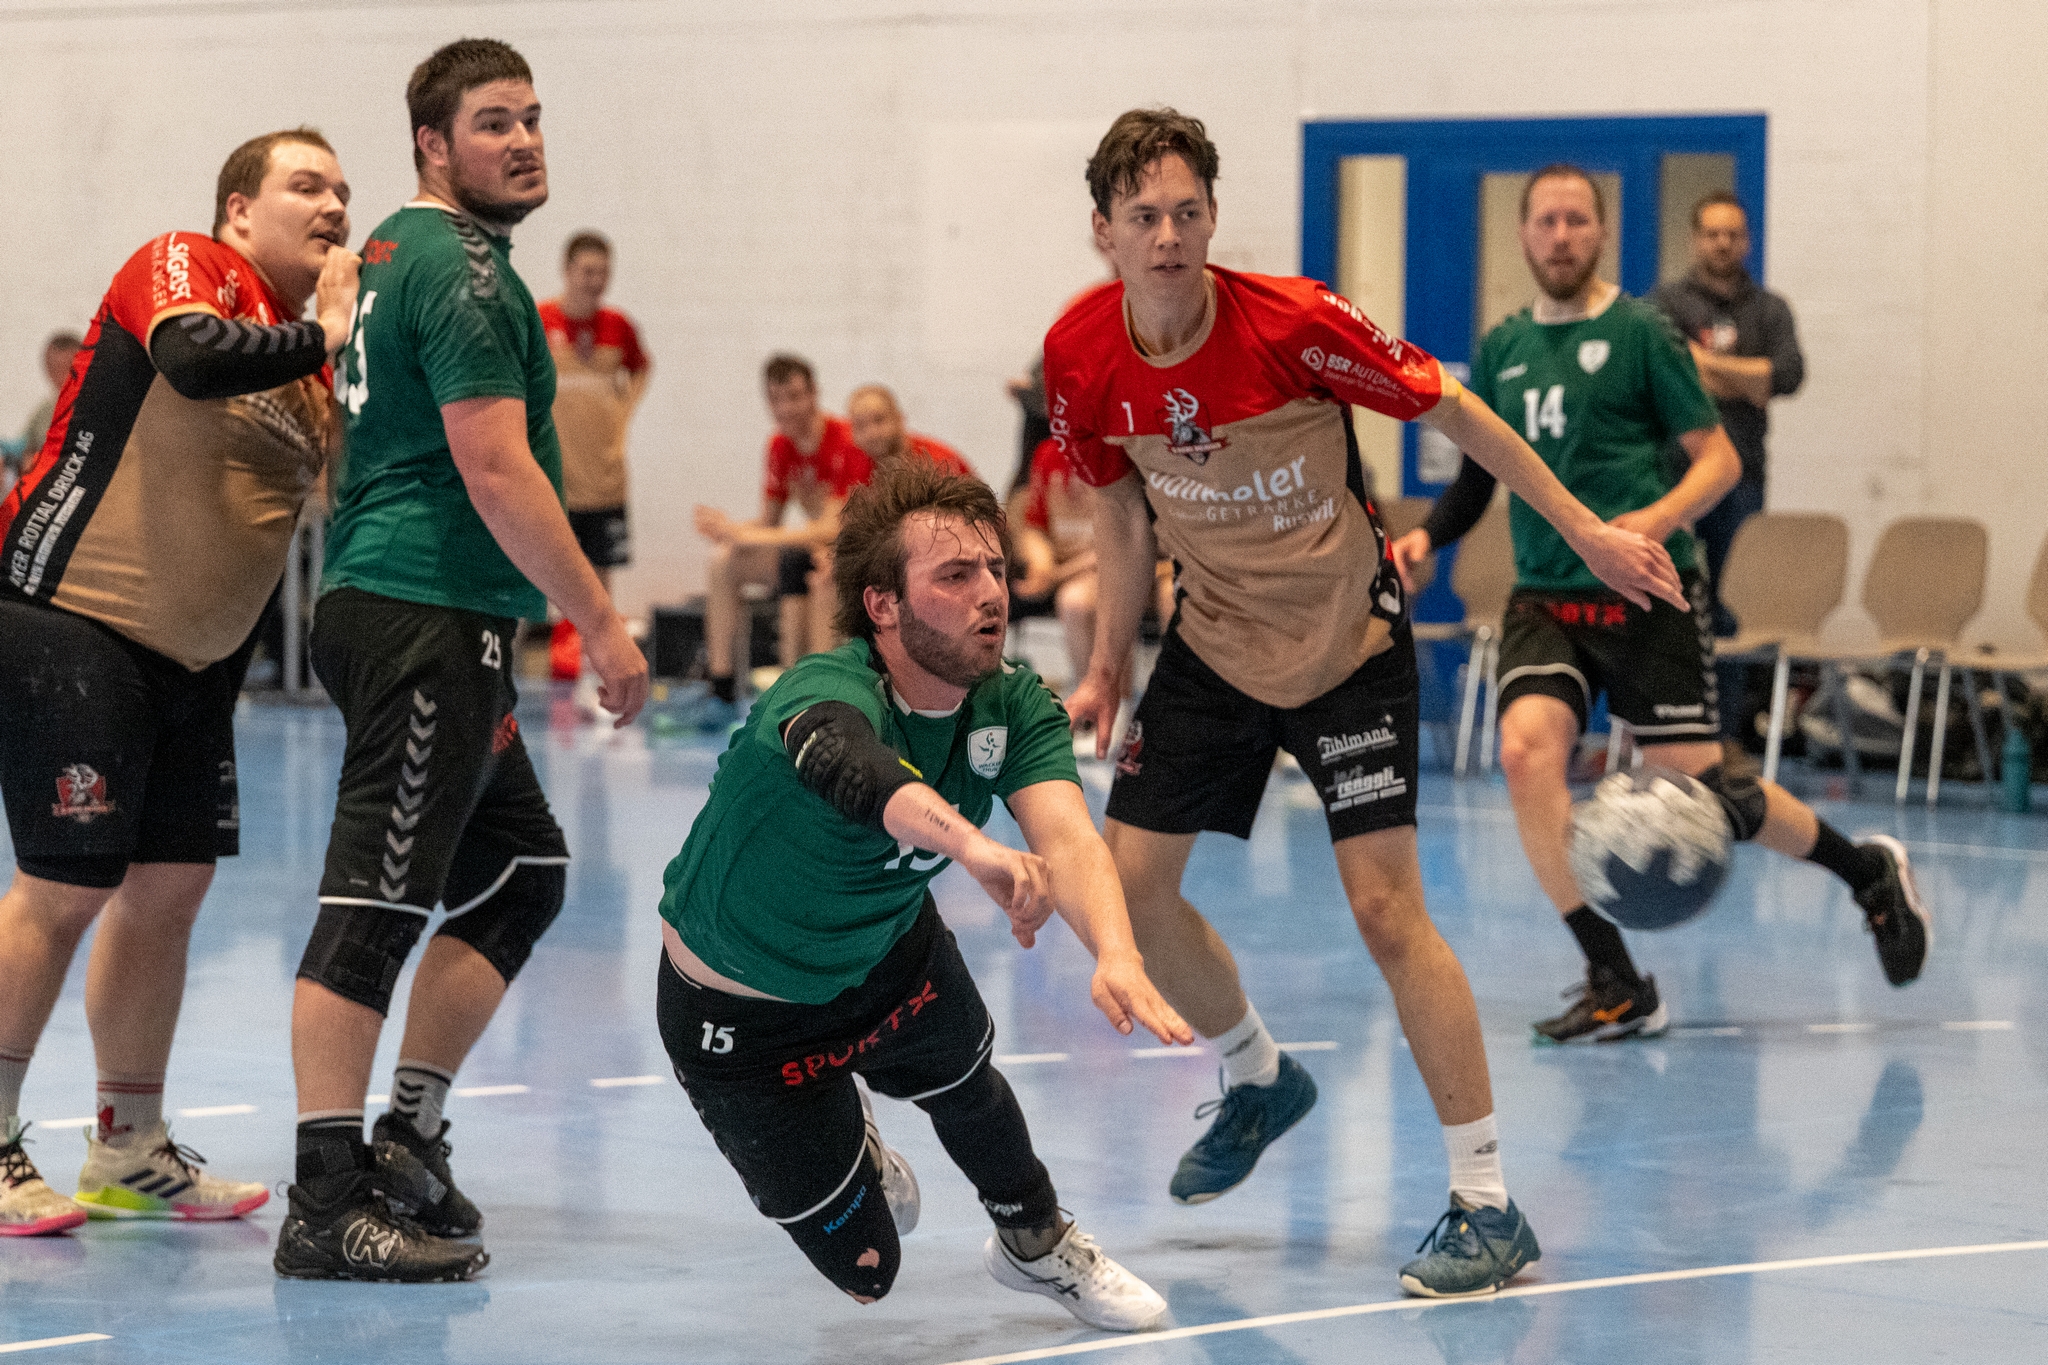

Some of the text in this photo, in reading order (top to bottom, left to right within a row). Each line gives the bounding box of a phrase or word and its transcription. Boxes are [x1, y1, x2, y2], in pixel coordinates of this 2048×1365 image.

[1121, 401, 1134, 434] 1
[1523, 384, 1567, 441] 14
[18, 500, 59, 550] ROTTAL
[48, 452, 87, 502] DRUCK
[76, 430, 95, 454] AG
[481, 629, 501, 670] 25
[978, 761, 1001, 769] WACKE
[701, 1020, 735, 1055] 15
[823, 1185, 867, 1235] Kempa
